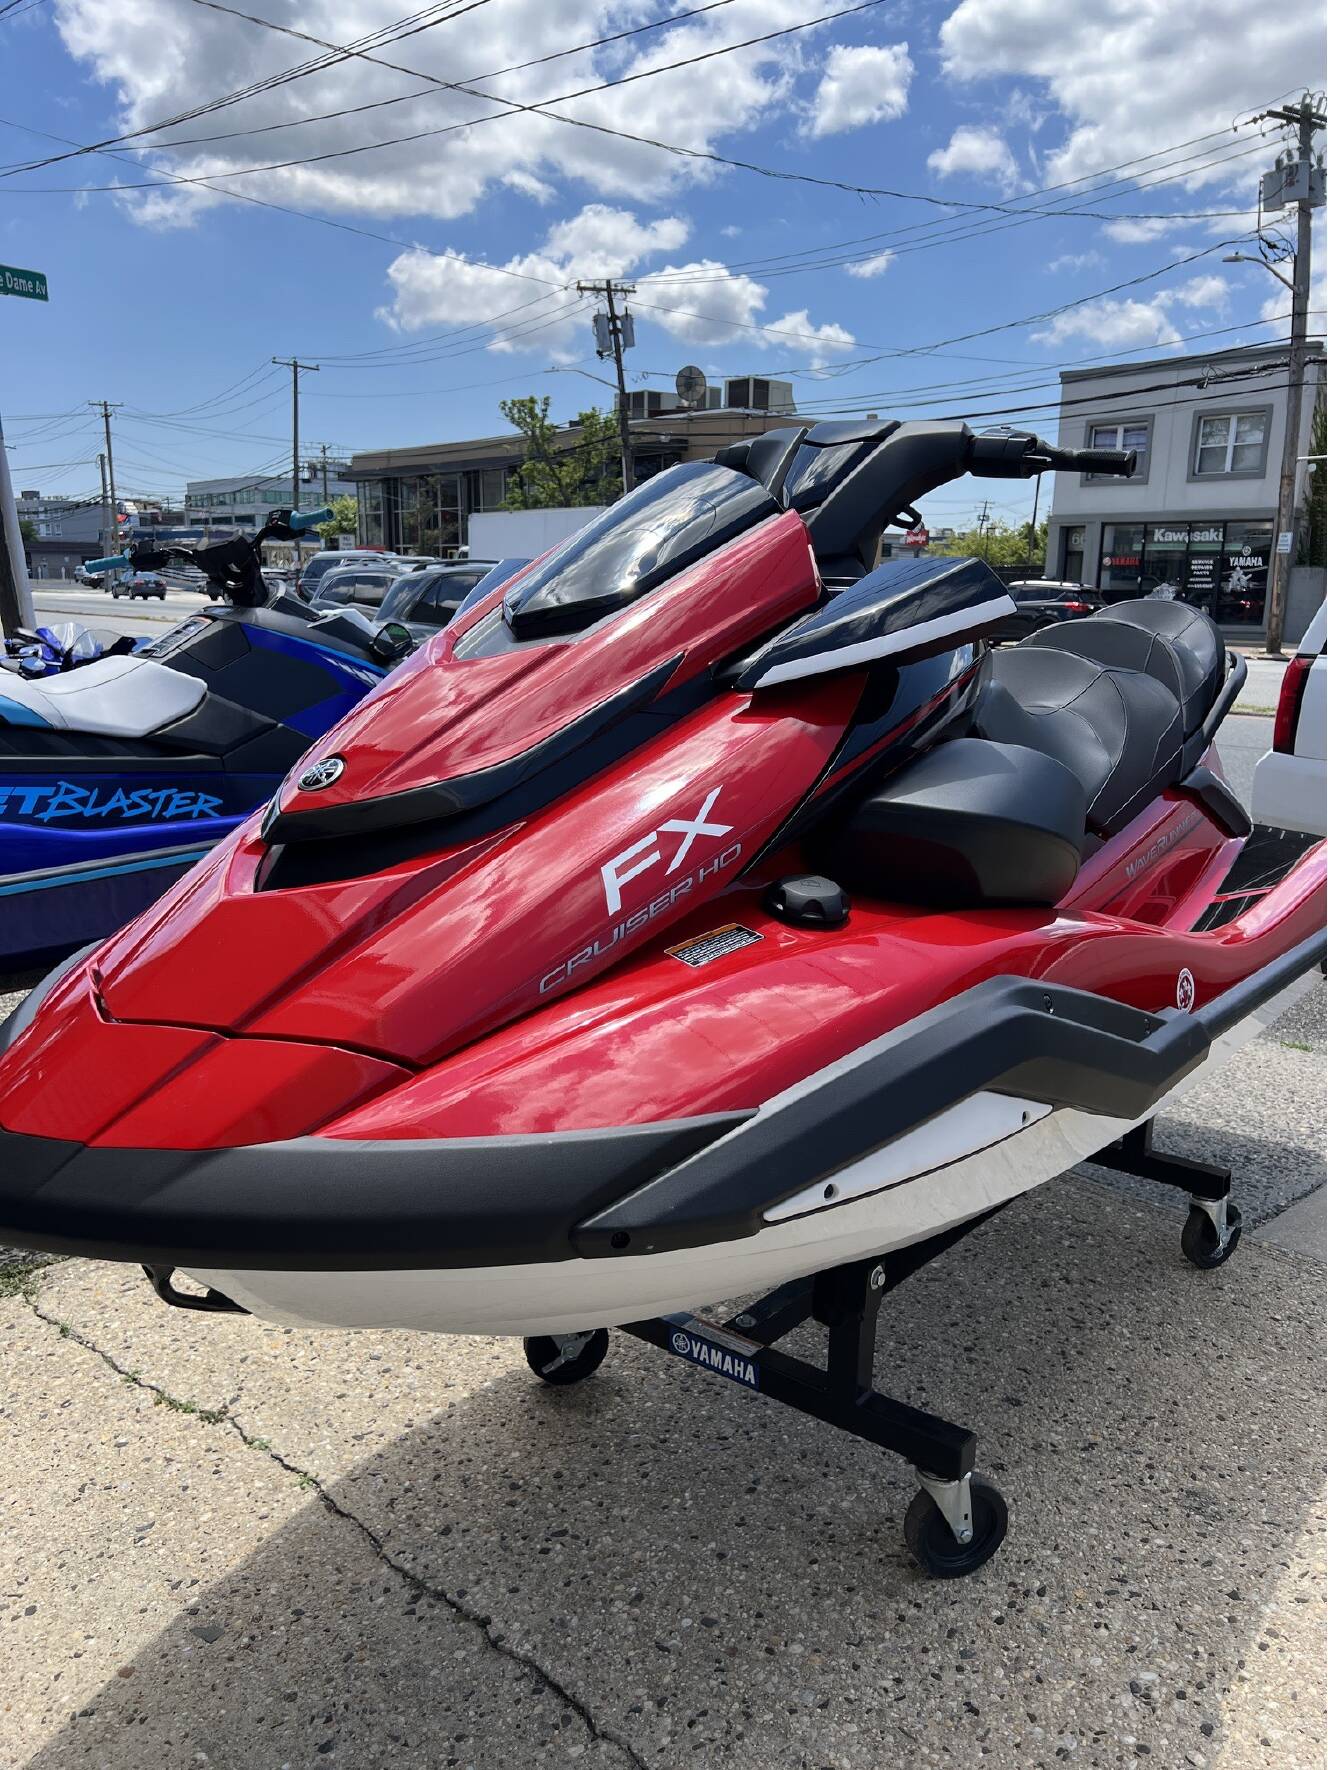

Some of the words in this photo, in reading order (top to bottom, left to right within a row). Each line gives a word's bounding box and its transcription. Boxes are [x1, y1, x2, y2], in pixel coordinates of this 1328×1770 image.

[5, 271, 33, 292] Dame
[36, 280, 46, 295] Av
[1229, 556, 1263, 567] YAMAHA
[601, 784, 734, 916] FX
[539, 877, 693, 994] CRUISER
[699, 843, 742, 884] HO
[691, 1340, 755, 1384] YAMAHA
